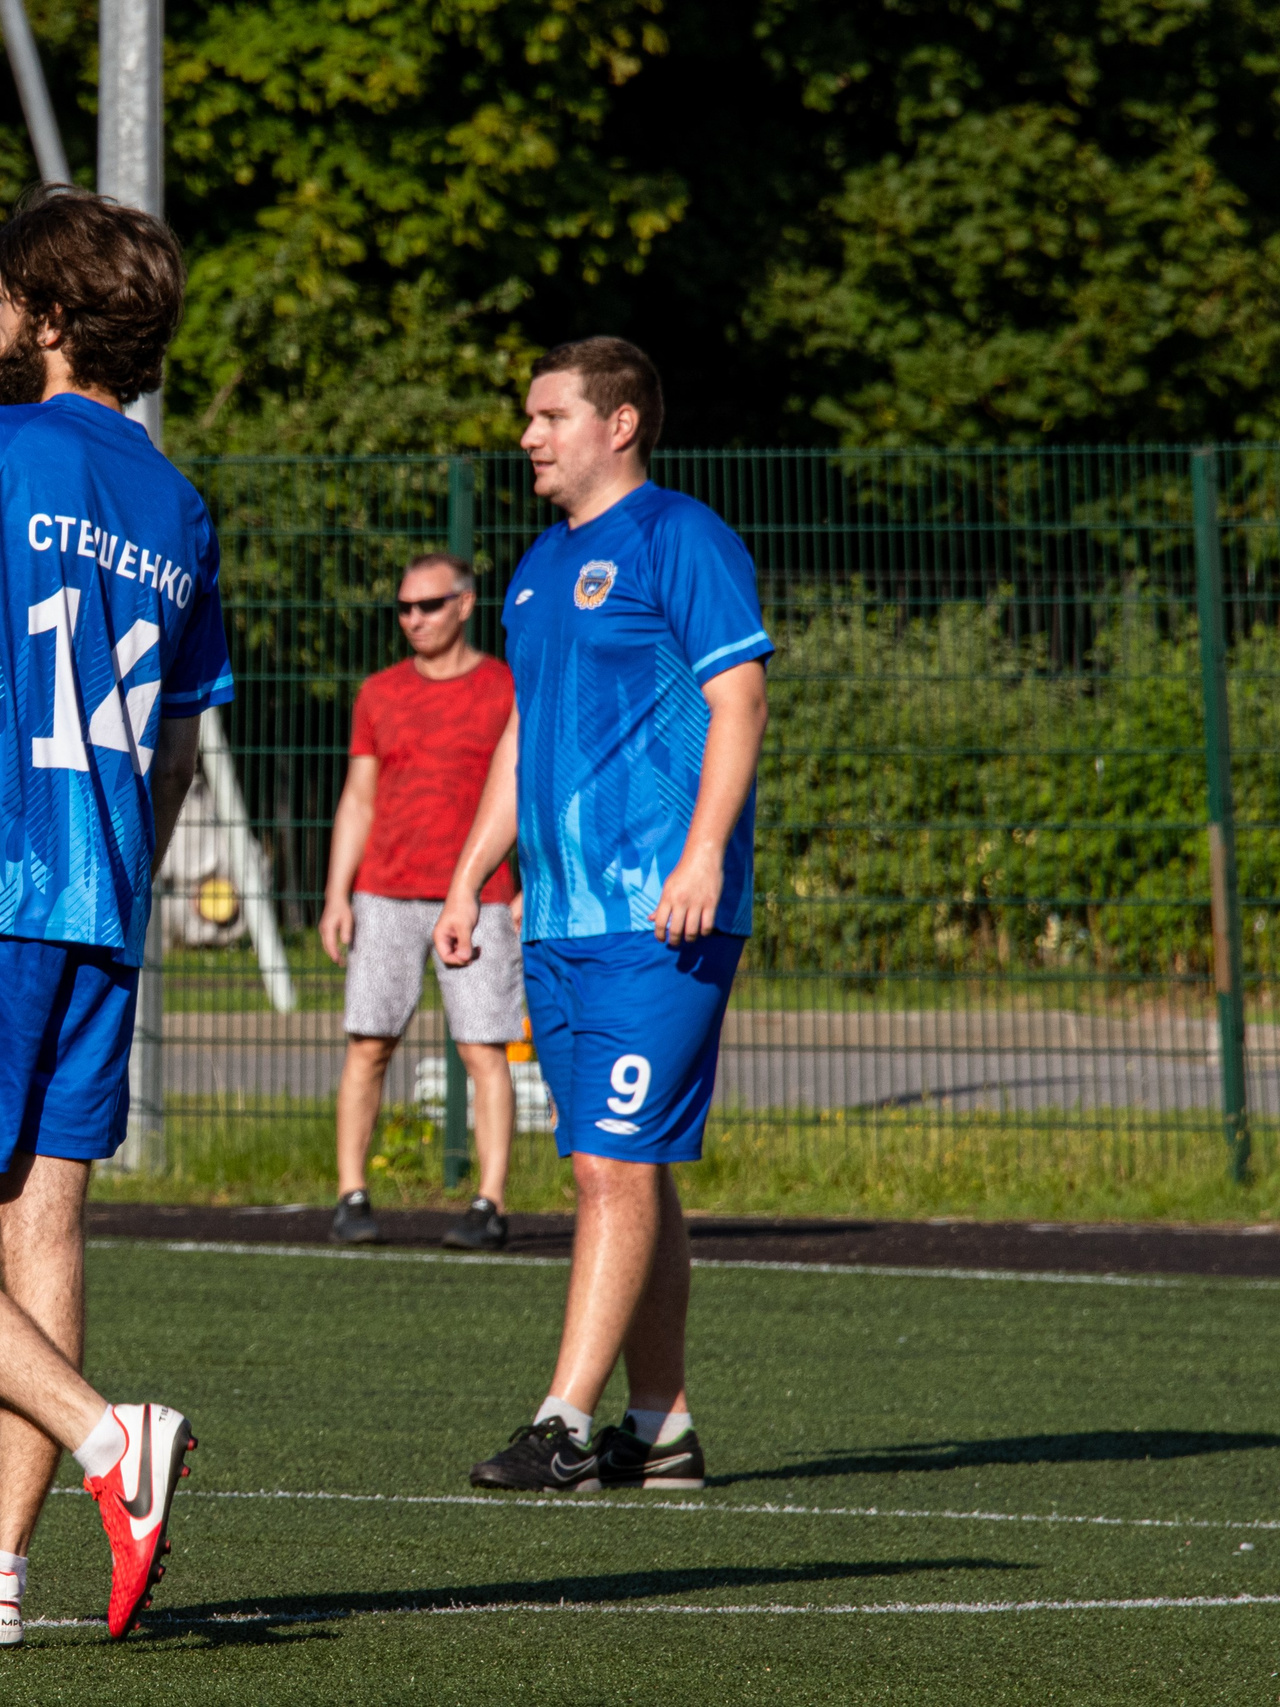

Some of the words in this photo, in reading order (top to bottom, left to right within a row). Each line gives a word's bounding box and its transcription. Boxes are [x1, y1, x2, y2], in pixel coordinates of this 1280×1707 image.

[27, 512, 193, 610] СТЕШЕНКО
[27, 585, 162, 778] 14
[606, 1053, 652, 1116] 9
